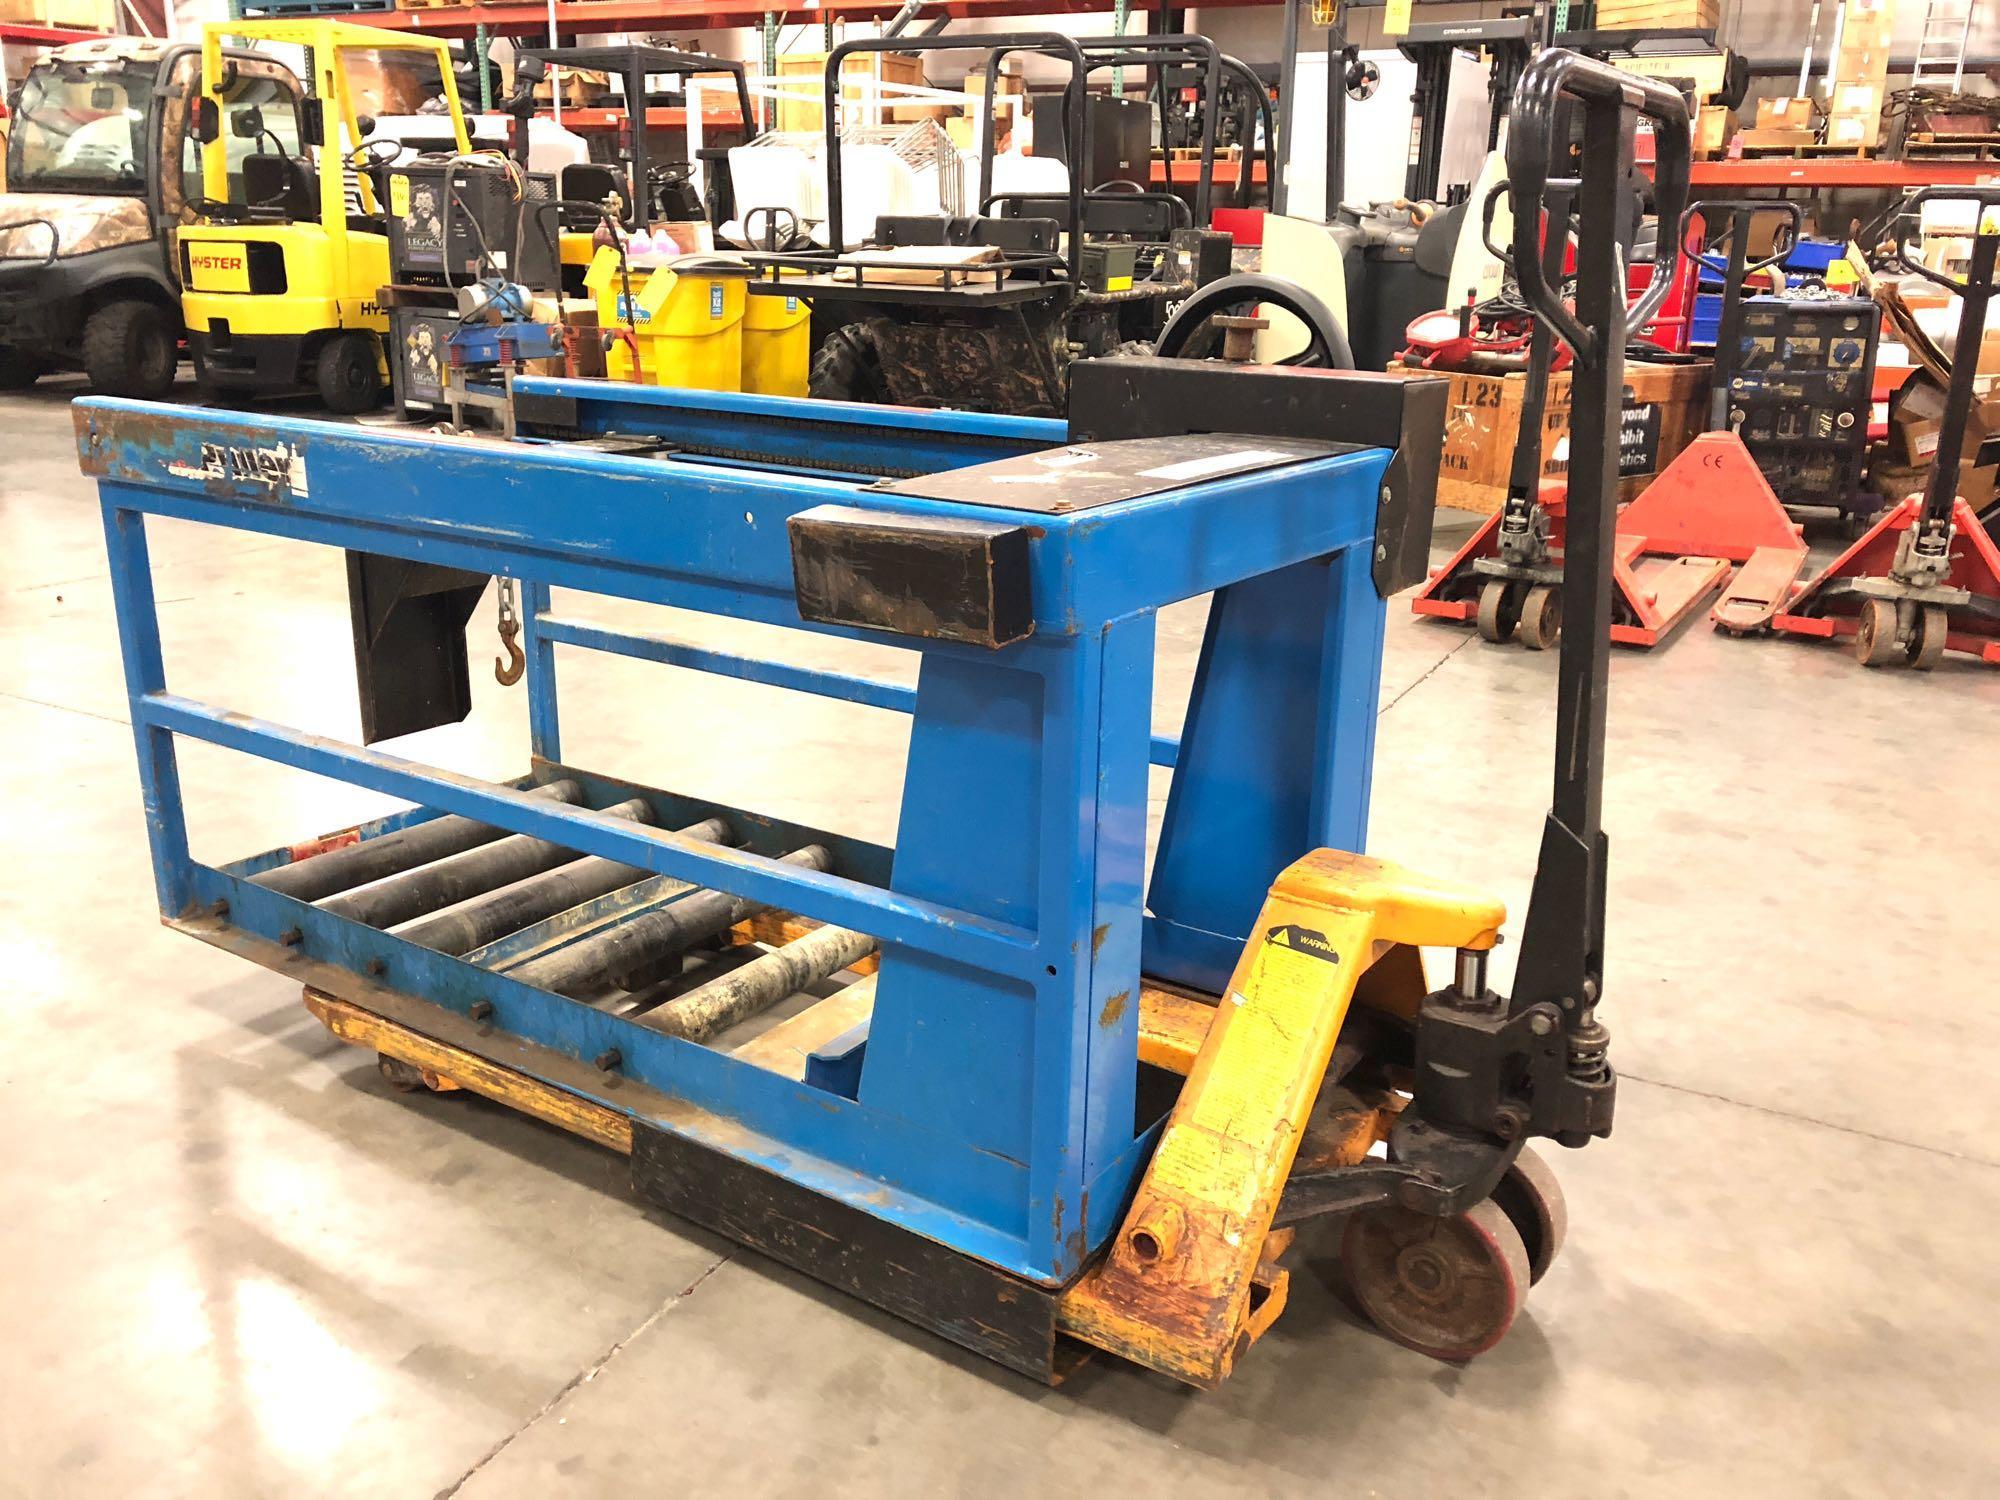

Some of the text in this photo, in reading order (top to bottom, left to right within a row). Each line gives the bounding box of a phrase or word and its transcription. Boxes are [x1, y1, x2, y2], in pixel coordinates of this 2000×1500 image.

[1443, 27, 1483, 36] crown.com
[407, 237, 443, 249] LEGACY
[191, 256, 242, 270] HYSTER
[1621, 404, 1651, 425] yond
[1702, 453, 1724, 469] CE
